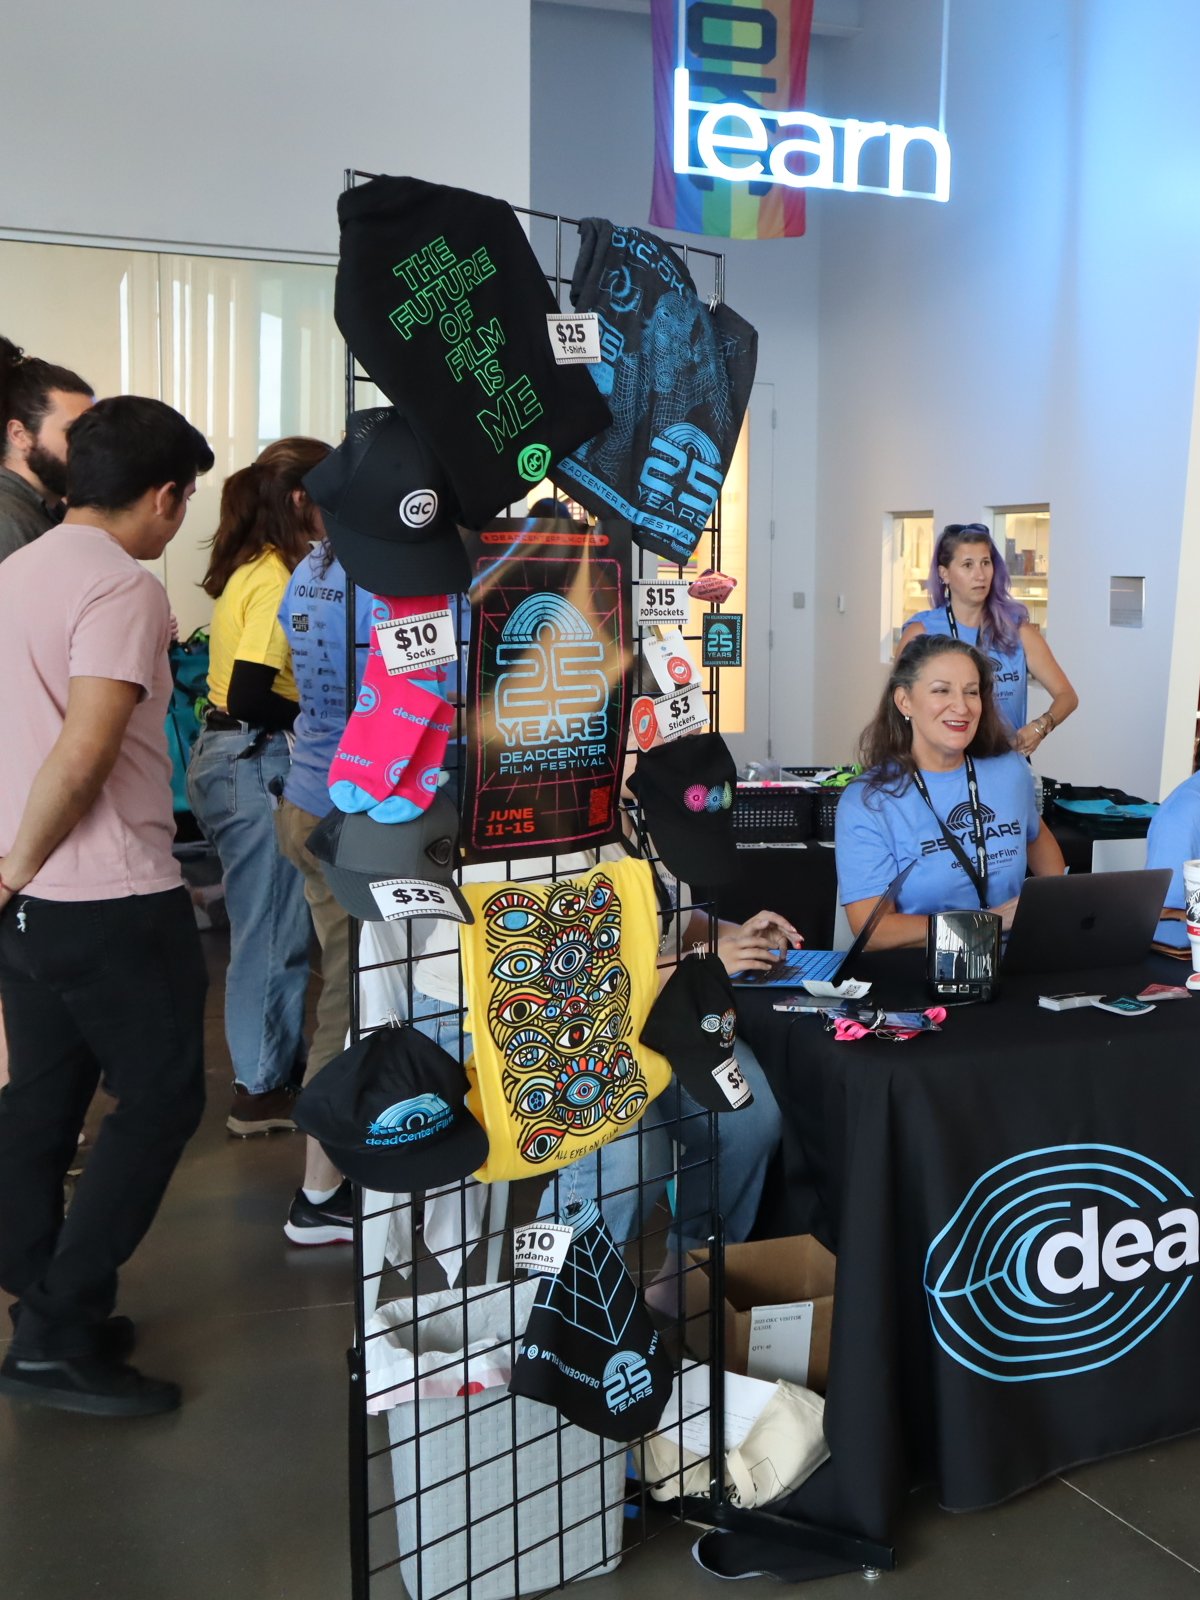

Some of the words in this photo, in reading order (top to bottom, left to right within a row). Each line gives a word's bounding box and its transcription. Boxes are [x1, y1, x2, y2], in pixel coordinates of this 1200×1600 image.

[673, 67, 950, 202] learn
[392, 235, 457, 291] THE
[388, 246, 497, 341] FUTURE
[439, 299, 474, 344] OF
[556, 323, 586, 345] $25
[445, 317, 506, 383] FILM
[562, 345, 587, 354] T-Shirts
[474, 359, 506, 397] IS
[476, 374, 544, 455] ME
[640, 436, 724, 514] 25
[560, 460, 618, 508] EADCENTER
[641, 517, 696, 543] FESTIVAL
[637, 484, 706, 529] YEARS
[646, 587, 675, 608] $15
[640, 608, 685, 617] POPSockets
[394, 623, 438, 652] $10
[708, 634, 733, 652] 25
[406, 647, 436, 661] Socks
[495, 641, 609, 719] 25
[669, 696, 690, 719] $3
[498, 715, 607, 745] YEARS
[668, 715, 696, 731] Stickers
[500, 744, 606, 764] DEADCENTER
[500, 764, 533, 775] FILM
[540, 757, 606, 771] FESTIVAL
[488, 808, 534, 822] JUNE
[484, 821, 536, 837] 11-15
[392, 888, 445, 904] $35
[554, 1149, 568, 1160] ALL
[515, 1232, 555, 1252] $10
[515, 1253, 554, 1263] ndanas
[603, 1358, 652, 1409] 25
[609, 1386, 653, 1416] YEARS
